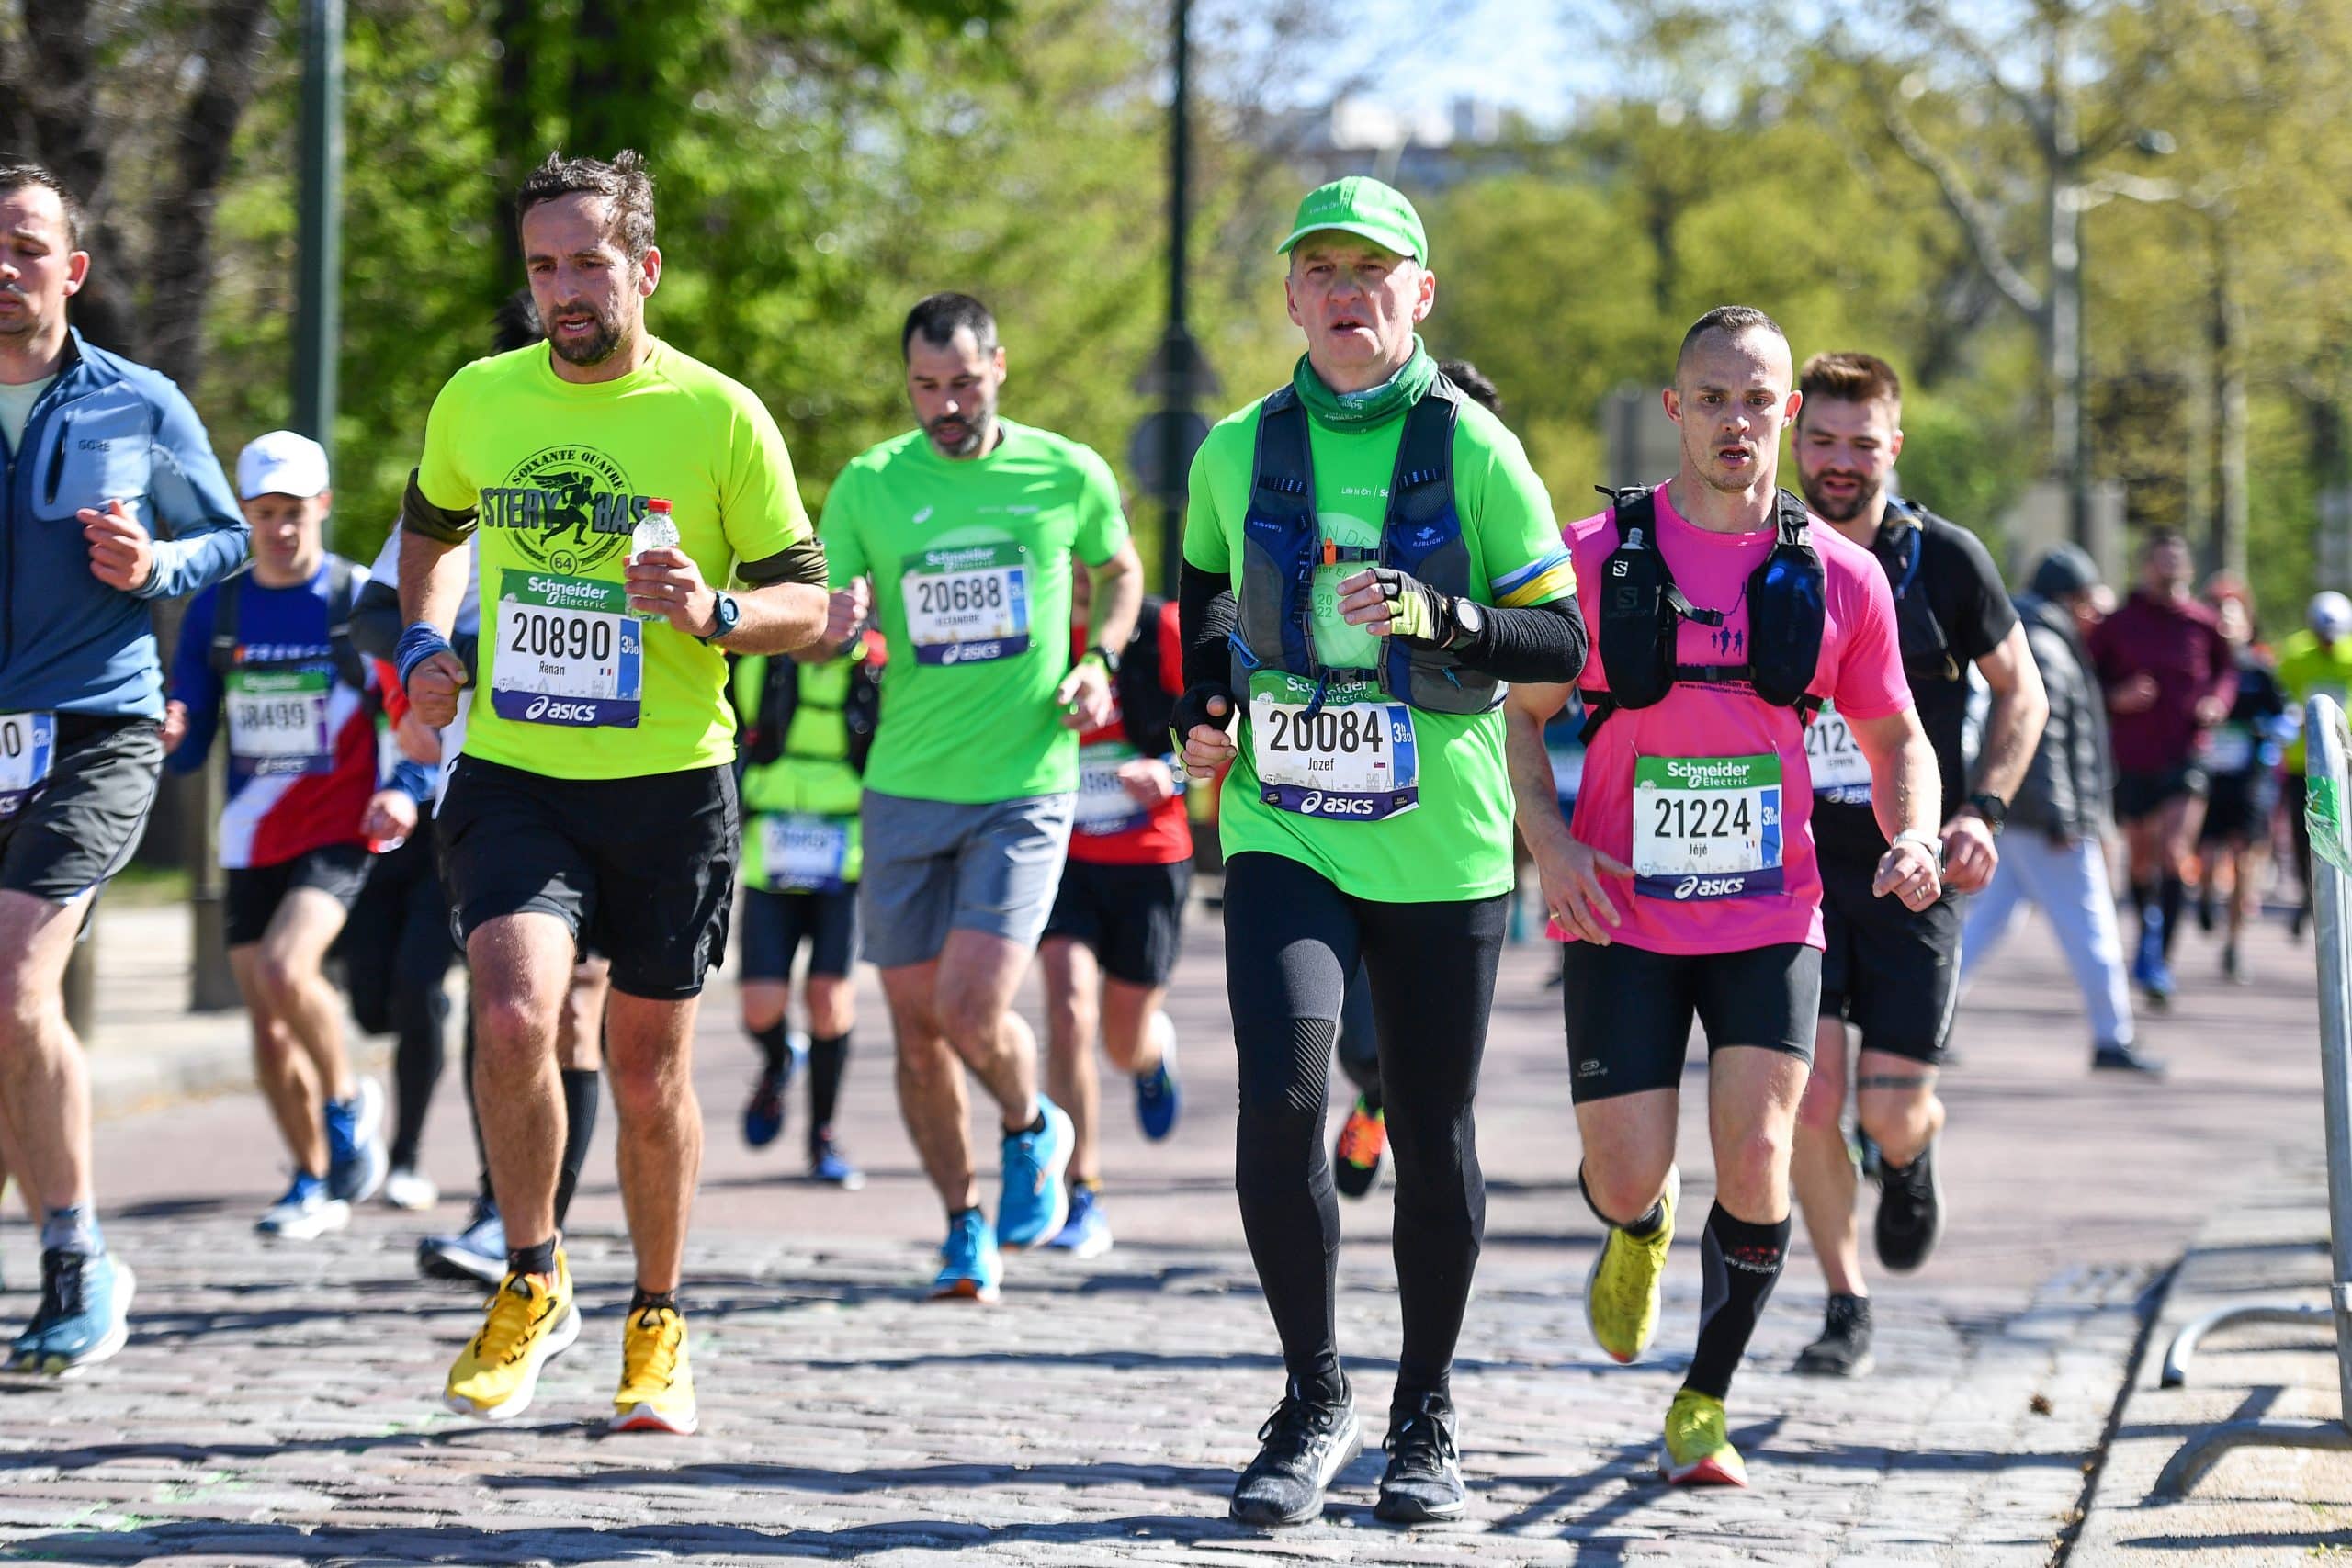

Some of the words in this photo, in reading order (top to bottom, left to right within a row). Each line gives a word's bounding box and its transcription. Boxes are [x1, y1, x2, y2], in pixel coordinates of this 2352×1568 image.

[512, 450, 577, 486] SOIXANTE
[581, 452, 626, 491] QUATRE
[554, 558, 572, 570] 64
[527, 576, 610, 600] Schneider
[918, 576, 1001, 614] 20688
[560, 596, 607, 610] Electric
[1317, 593, 1333, 606] 20
[1317, 606, 1332, 618] 22
[511, 611, 611, 661] 20890
[538, 660, 565, 676] Renan
[1286, 676, 1369, 696] Scheider
[1269, 709, 1384, 753] 20084
[1805, 721, 1861, 756] 212
[1307, 756, 1335, 772] Jozef
[1667, 761, 1750, 778] Schneider
[1702, 776, 1749, 787] Electric
[1654, 797, 1751, 839] 21224
